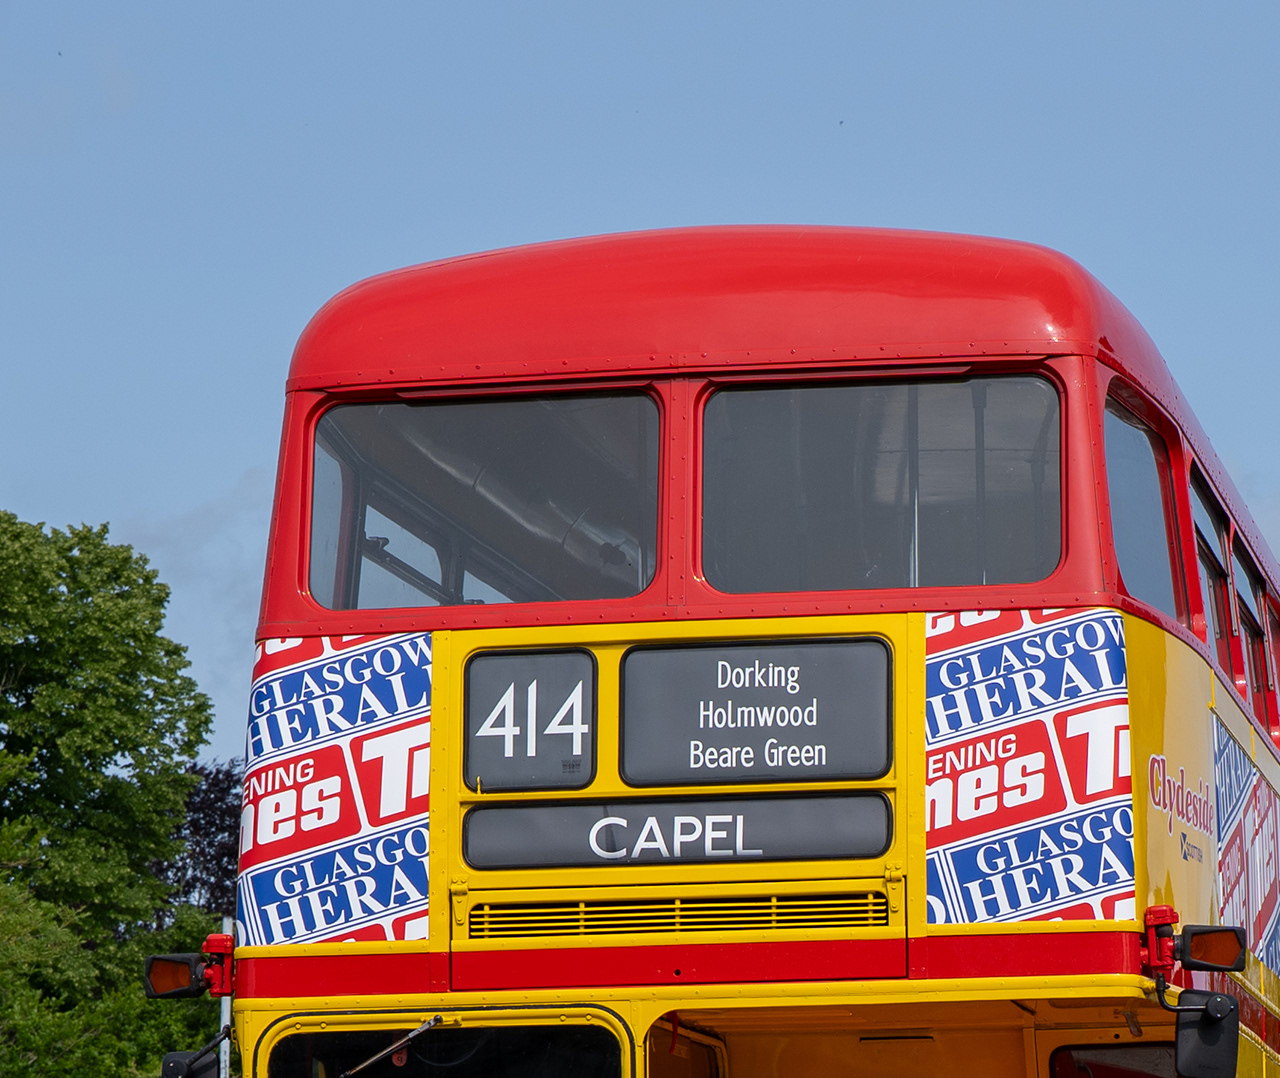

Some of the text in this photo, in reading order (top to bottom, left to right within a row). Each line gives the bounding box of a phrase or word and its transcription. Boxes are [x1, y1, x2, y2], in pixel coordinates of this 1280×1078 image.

[246, 664, 431, 764] HERAL
[475, 678, 589, 758] 414
[698, 699, 818, 730] Holmwood
[716, 659, 800, 695] Dorking
[926, 647, 1129, 738] HERAL
[689, 738, 827, 770] Beare Green
[588, 814, 764, 860] CAPEL
[1148, 754, 1214, 838] Clydeside
[261, 857, 430, 945] HERA
[963, 837, 1136, 923] HERA
